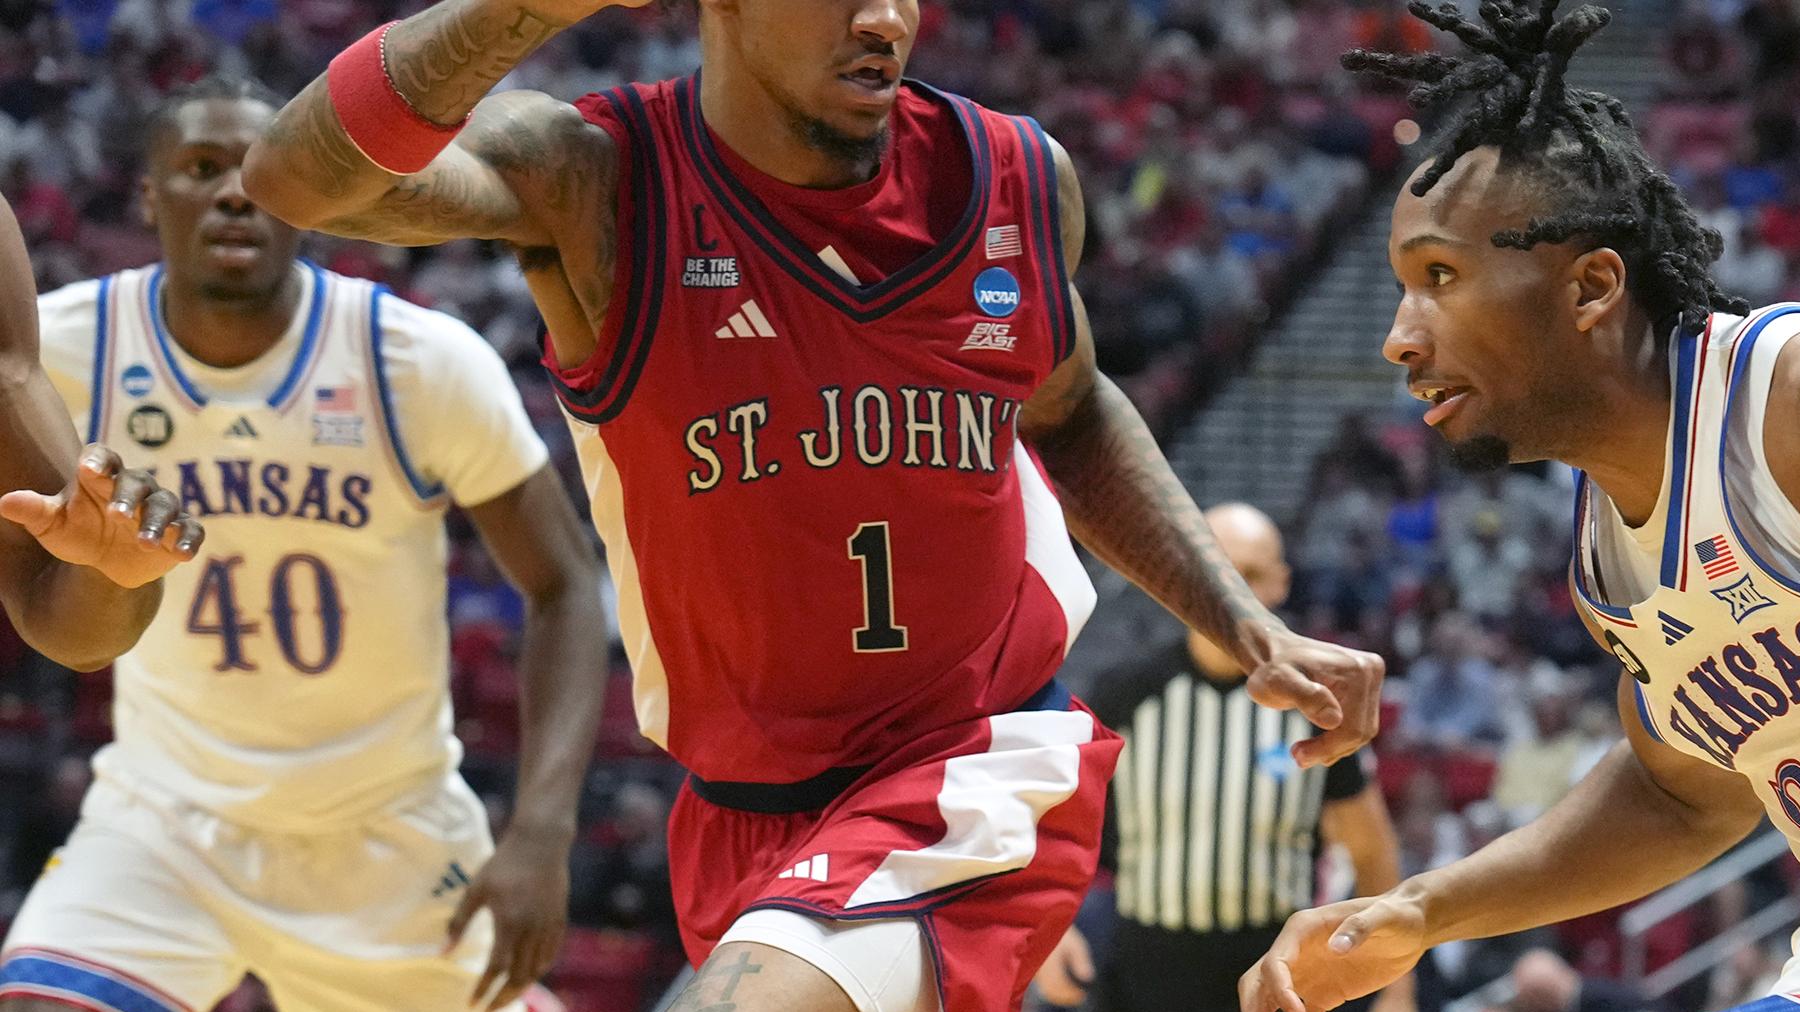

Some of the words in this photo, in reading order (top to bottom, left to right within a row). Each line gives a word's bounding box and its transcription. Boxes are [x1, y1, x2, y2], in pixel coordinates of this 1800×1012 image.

[686, 258, 706, 273] BE
[709, 257, 737, 273] THE
[682, 271, 740, 288] CHANGE
[980, 289, 1019, 305] NCAA
[970, 322, 1012, 336] BIG
[962, 335, 1019, 349] EAST
[683, 398, 783, 497] ST.
[798, 384, 1023, 474] JOHN'
[148, 457, 373, 529] ANSAS
[846, 520, 909, 654] 1
[185, 551, 348, 677] 40
